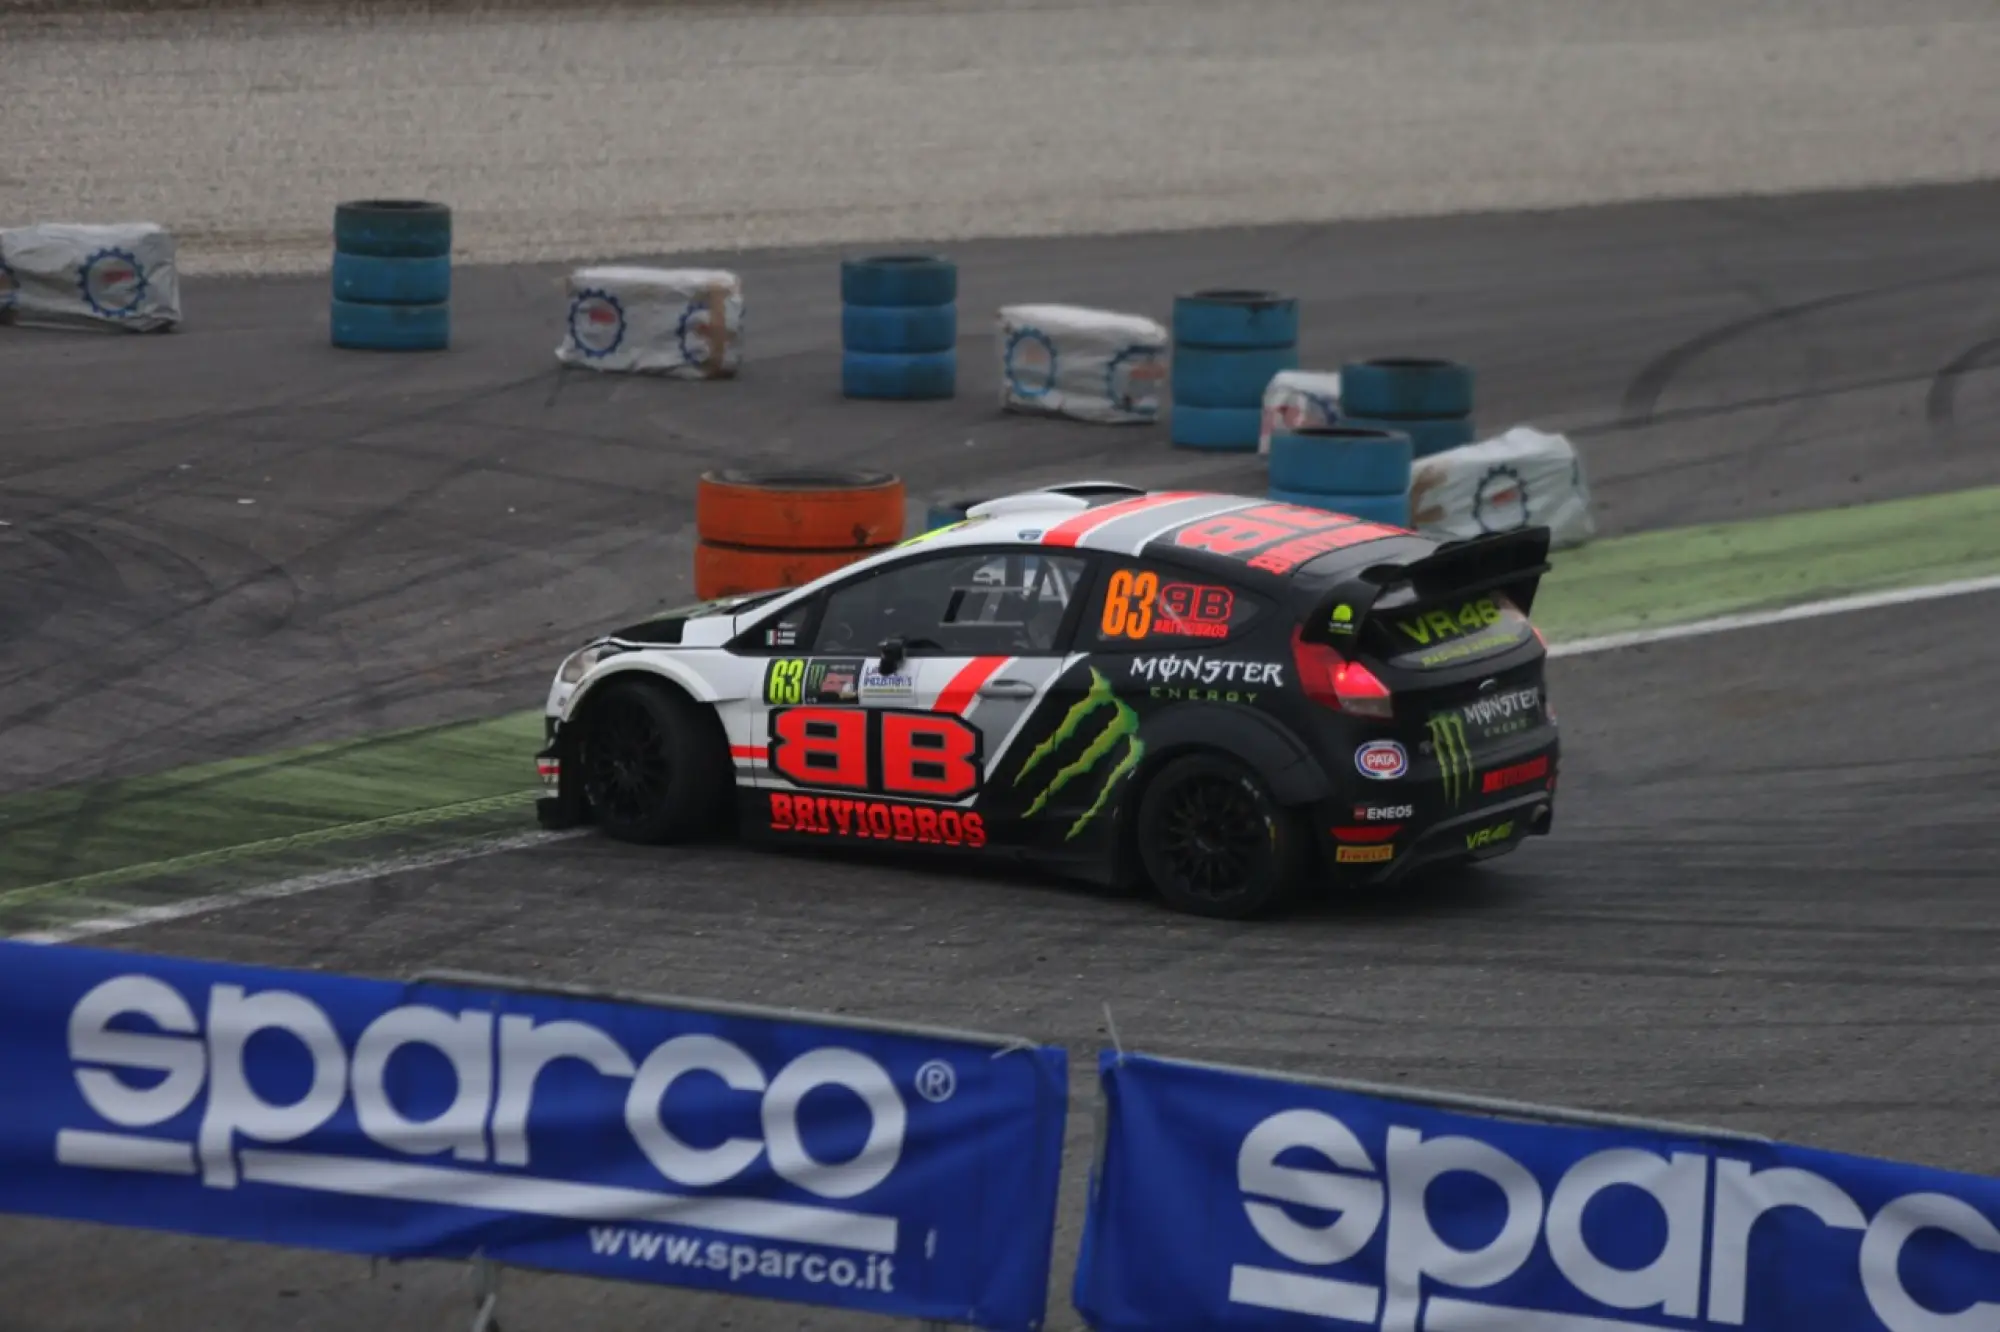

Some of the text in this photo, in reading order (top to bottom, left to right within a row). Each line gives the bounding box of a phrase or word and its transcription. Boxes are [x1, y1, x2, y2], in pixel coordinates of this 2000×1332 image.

[1101, 569, 1158, 639] 63
[769, 659, 804, 704] 63
[774, 705, 978, 797] BB
[1366, 753, 1397, 770] PATA
[769, 793, 986, 848] BRIVIOBROS
[1366, 804, 1413, 820] ENEOS
[67, 974, 907, 1199] sparco
[590, 1225, 895, 1293] www.sparco.it
